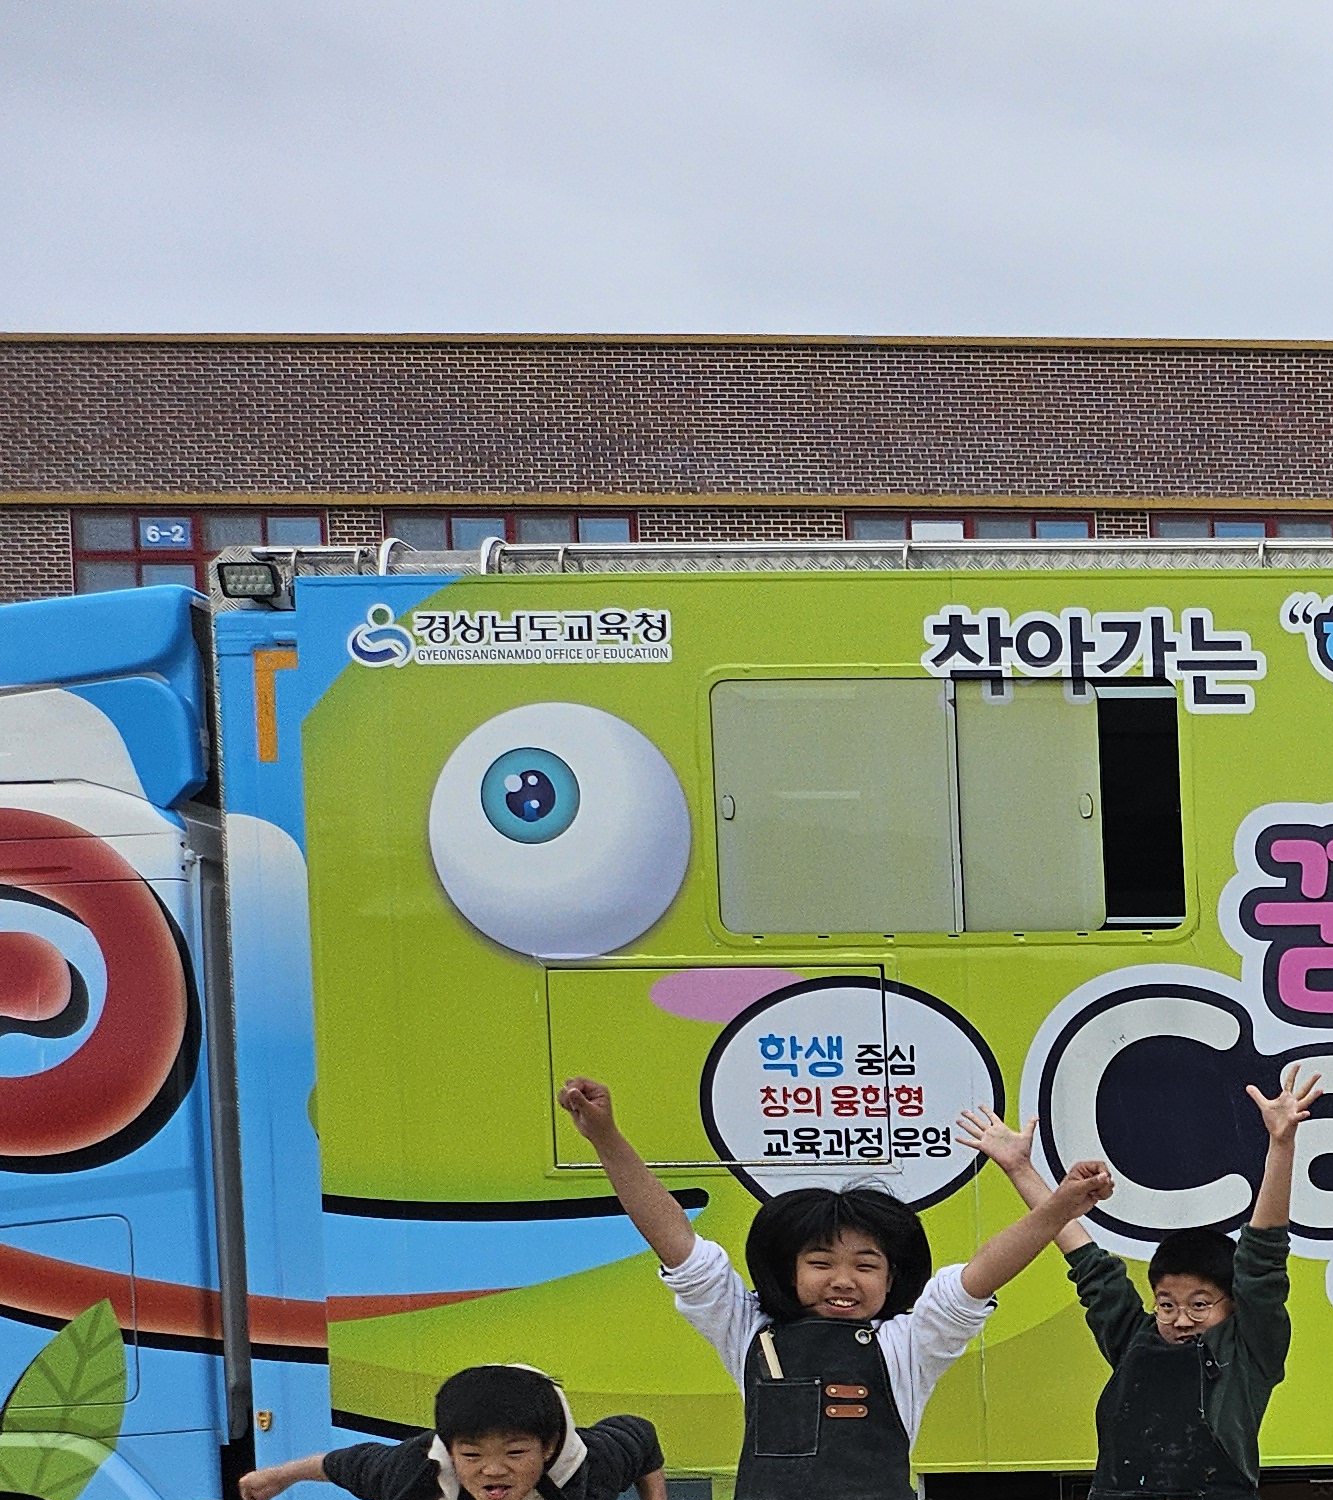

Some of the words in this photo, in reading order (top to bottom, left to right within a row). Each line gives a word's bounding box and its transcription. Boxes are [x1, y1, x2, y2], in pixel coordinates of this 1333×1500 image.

[146, 525, 186, 543] 6-2
[417, 612, 667, 643] 경상남도교육청
[418, 648, 542, 661] GYEONGSANGNAMDO
[545, 648, 583, 660] OFFICE
[586, 648, 601, 660] OF
[603, 647, 669, 660] EDUCATION
[758, 1033, 844, 1078] 학생
[854, 1044, 916, 1076] 중심
[760, 1086, 822, 1118] 창의
[830, 1085, 923, 1117] 융합형
[763, 1127, 883, 1159] 교육과정
[892, 1126, 951, 1158] 운영
